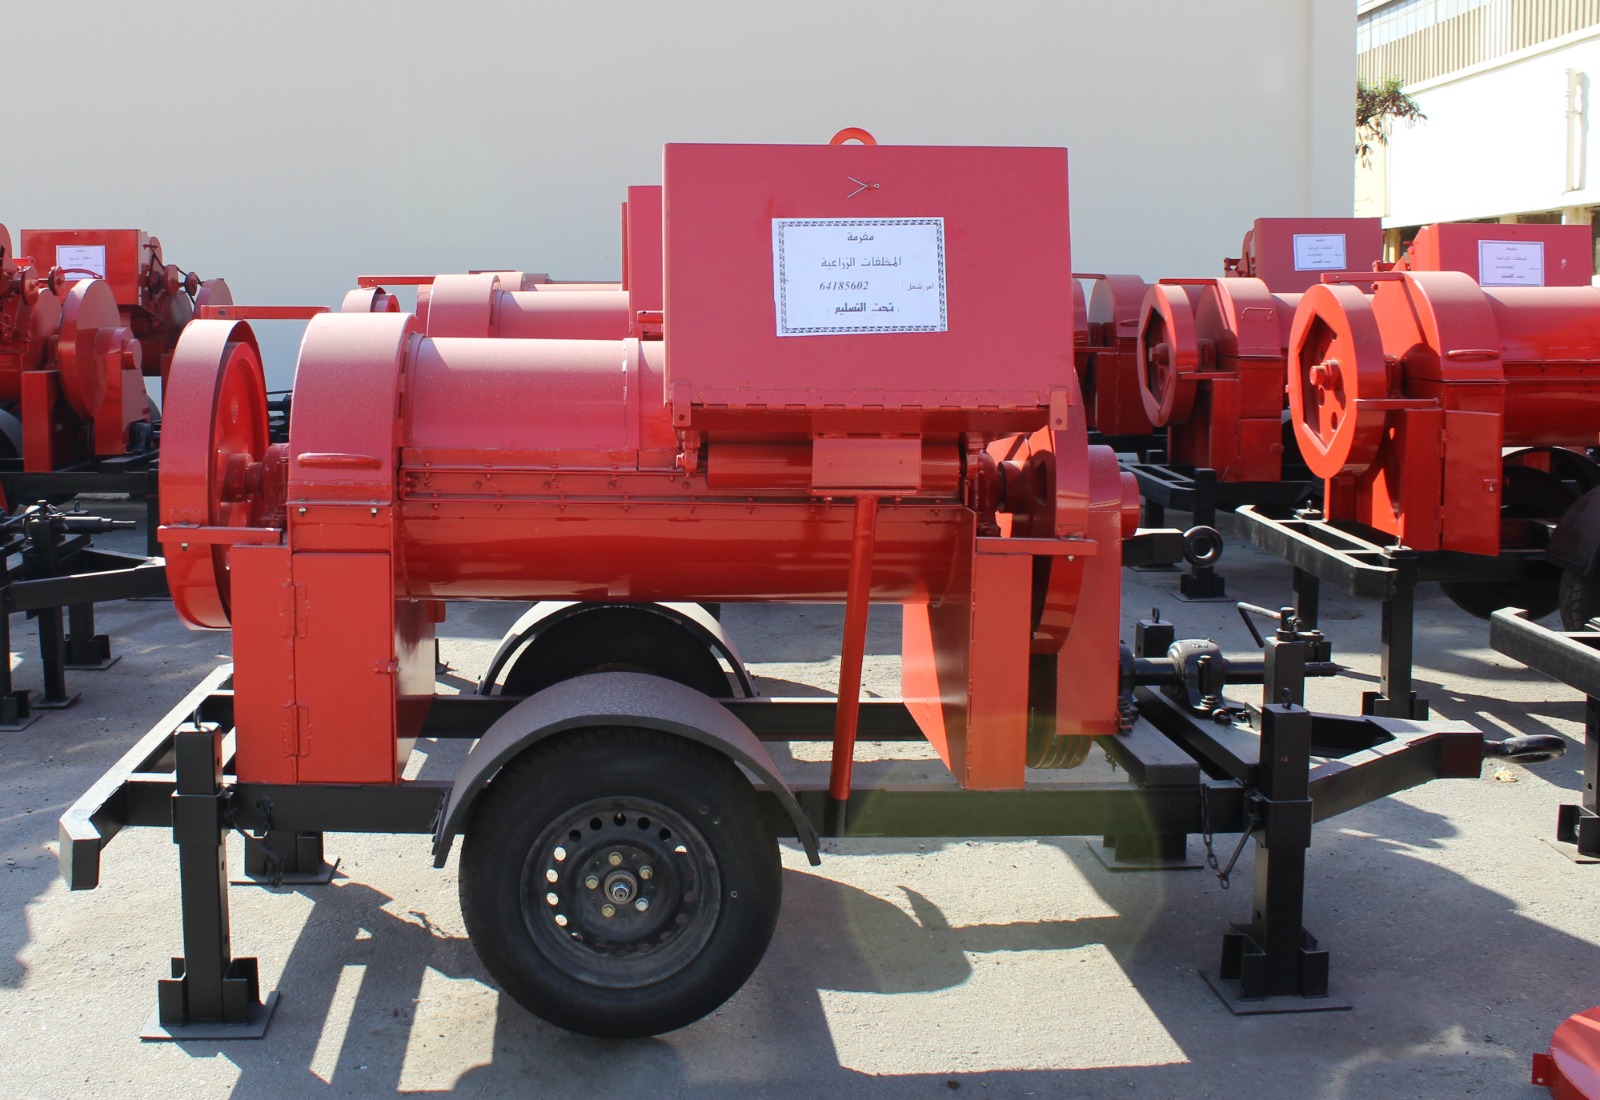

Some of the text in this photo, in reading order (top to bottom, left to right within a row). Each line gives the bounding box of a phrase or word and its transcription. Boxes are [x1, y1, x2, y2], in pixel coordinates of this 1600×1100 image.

[847, 231, 874, 244] مفرمة
[821, 256, 902, 270] المخلفات الزراعية
[819, 280, 869, 291] 64185602
[834, 302, 866, 315] التسليم
[871, 302, 894, 312] تحت
